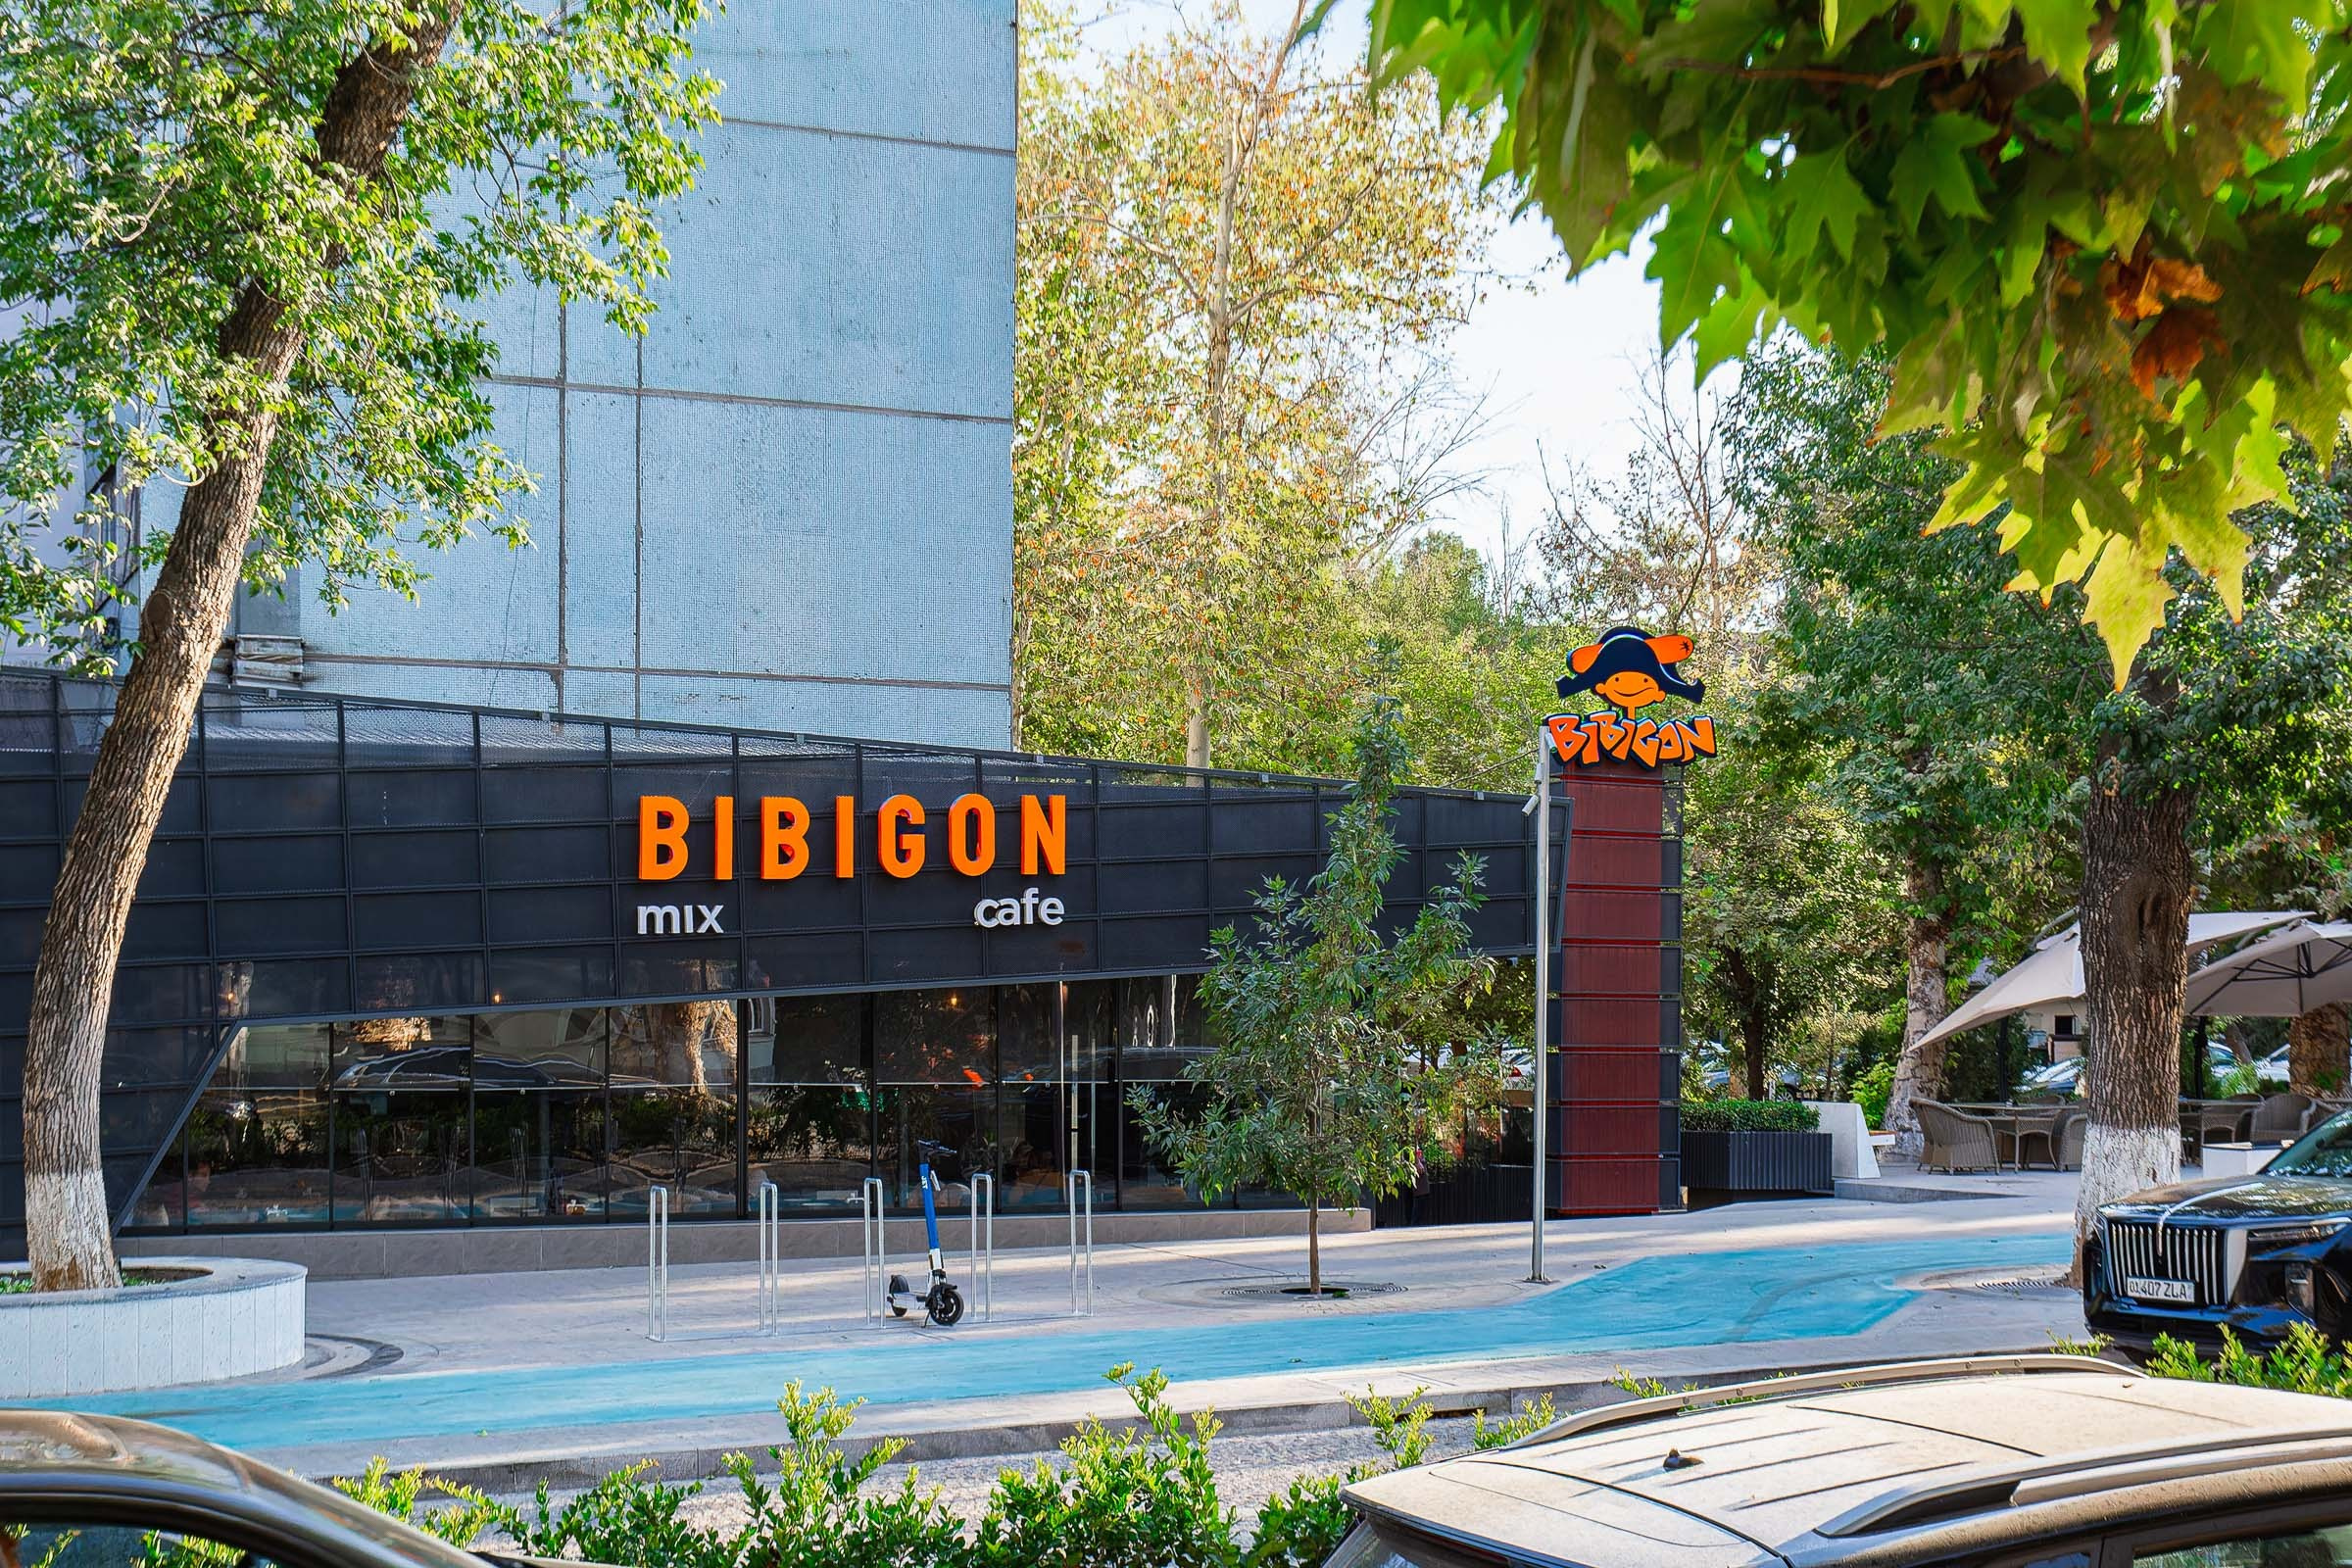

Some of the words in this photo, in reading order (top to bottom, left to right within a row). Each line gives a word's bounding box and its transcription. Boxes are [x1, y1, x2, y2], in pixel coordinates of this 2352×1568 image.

[1545, 710, 1717, 769] BIBIGON
[639, 793, 1066, 879] BIBIGON
[636, 904, 724, 935] mix
[974, 887, 1065, 928] cafe
